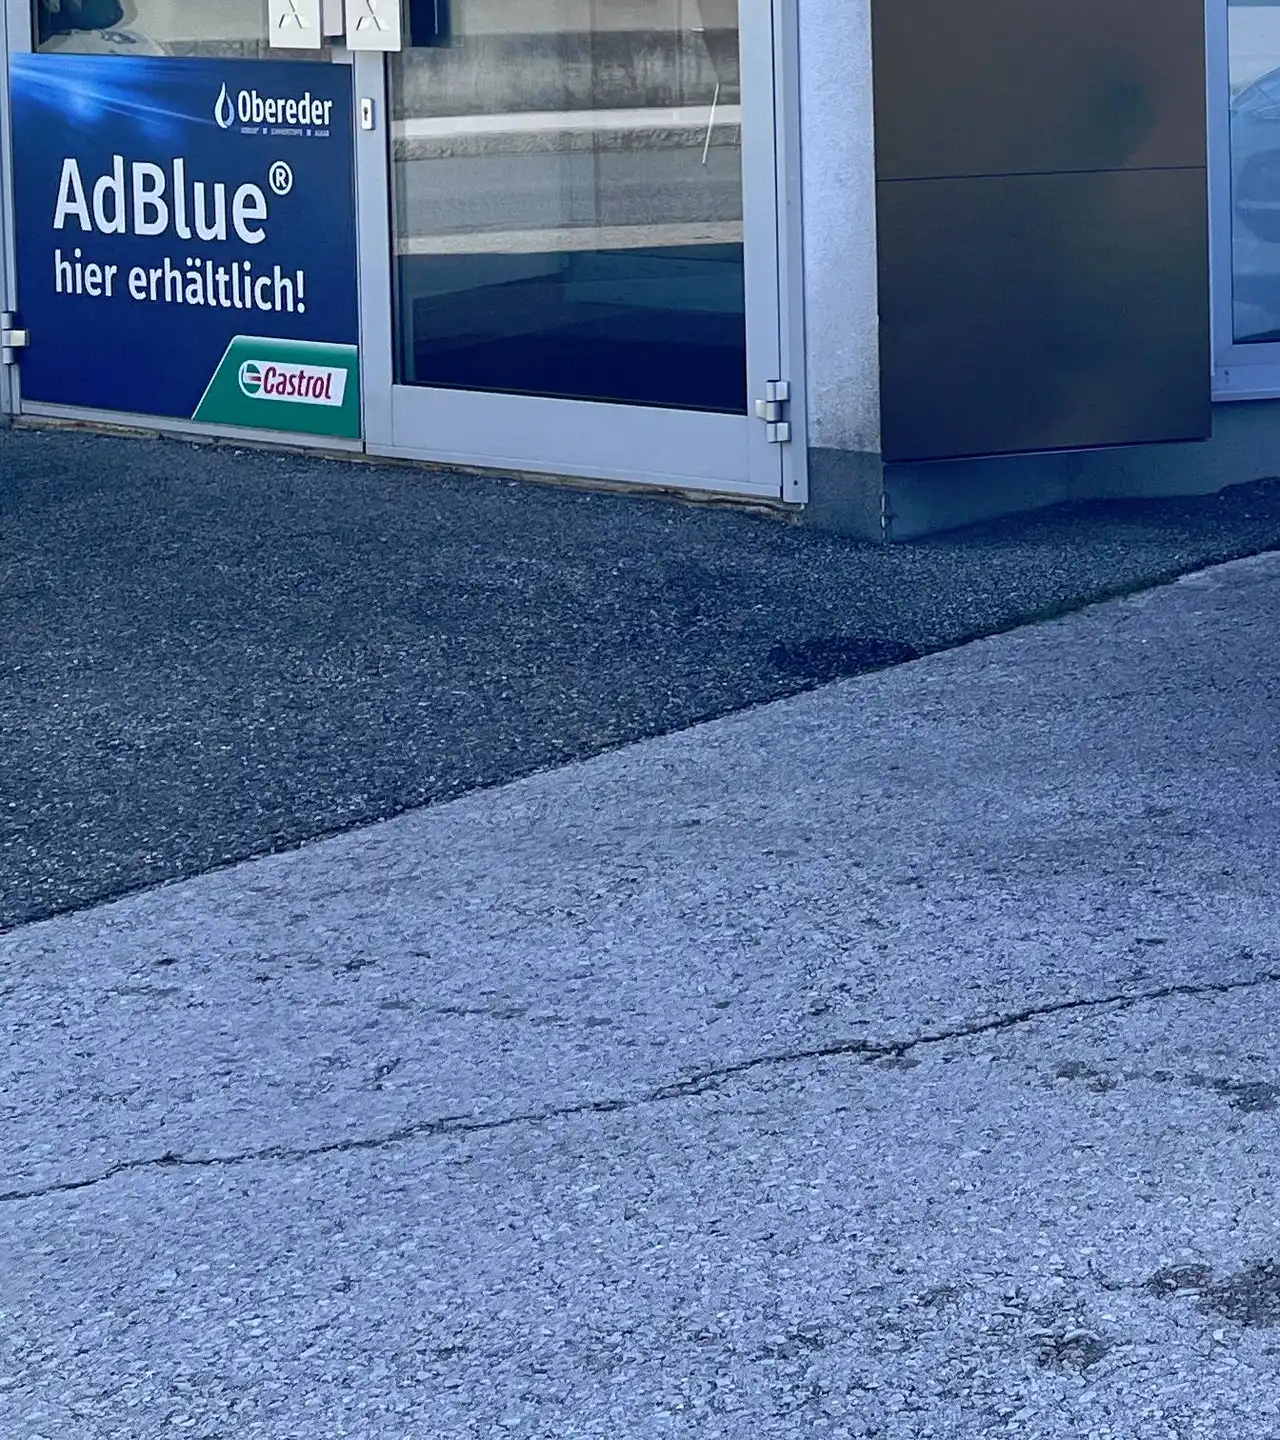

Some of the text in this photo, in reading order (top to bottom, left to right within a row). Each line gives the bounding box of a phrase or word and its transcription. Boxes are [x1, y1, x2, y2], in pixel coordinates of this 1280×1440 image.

[237, 89, 333, 125] Obereder
[54, 248, 306, 314] hier erhältlich!
[263, 365, 333, 400] Castrol
